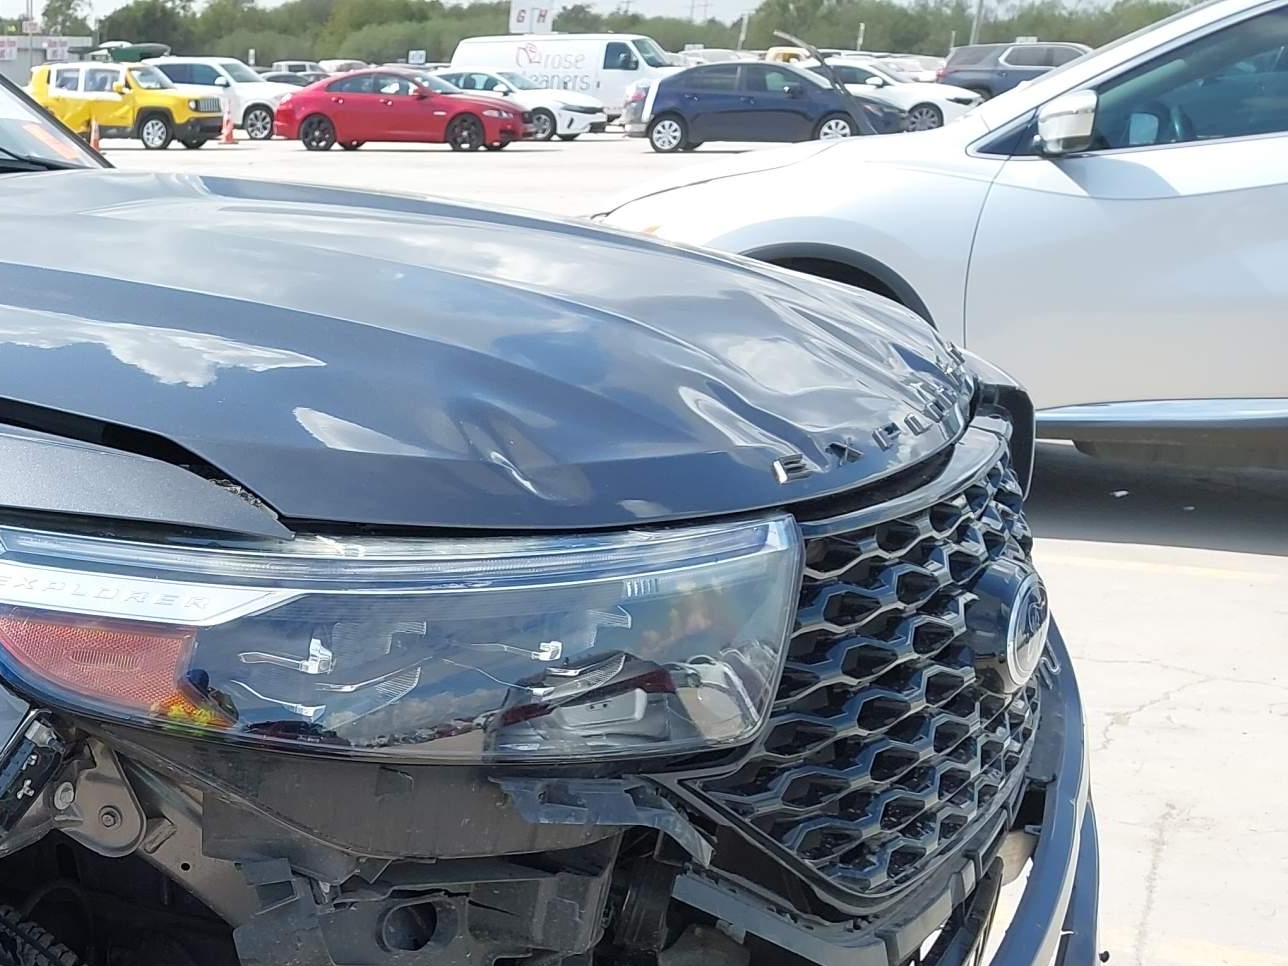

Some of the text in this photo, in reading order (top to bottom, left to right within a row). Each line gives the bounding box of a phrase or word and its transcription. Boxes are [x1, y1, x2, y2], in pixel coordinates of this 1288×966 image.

[536, 9, 548, 24] H
[543, 54, 585, 70] rose
[522, 71, 592, 90] eaners
